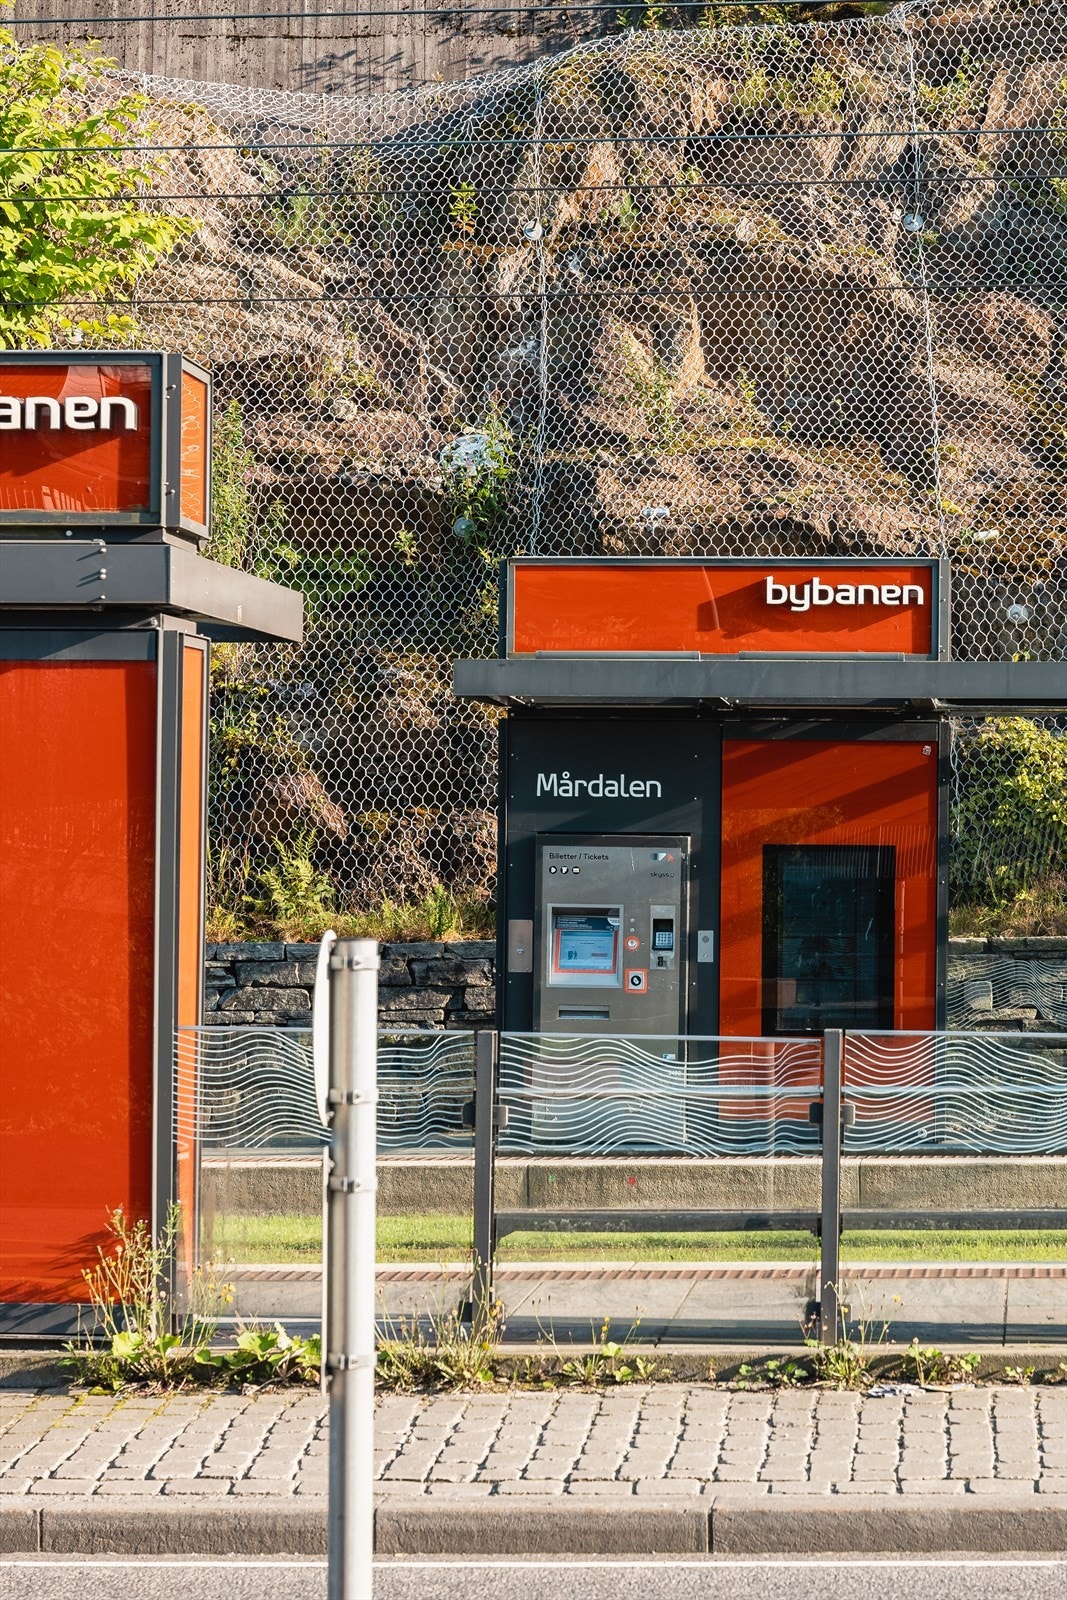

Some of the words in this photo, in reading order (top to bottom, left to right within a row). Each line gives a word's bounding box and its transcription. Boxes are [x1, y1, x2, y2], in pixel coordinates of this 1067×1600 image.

[765, 576, 924, 611] bybanen
[536, 772, 662, 798] Mårdalen
[549, 852, 577, 860] Billetter
[583, 852, 609, 861] Tickets
